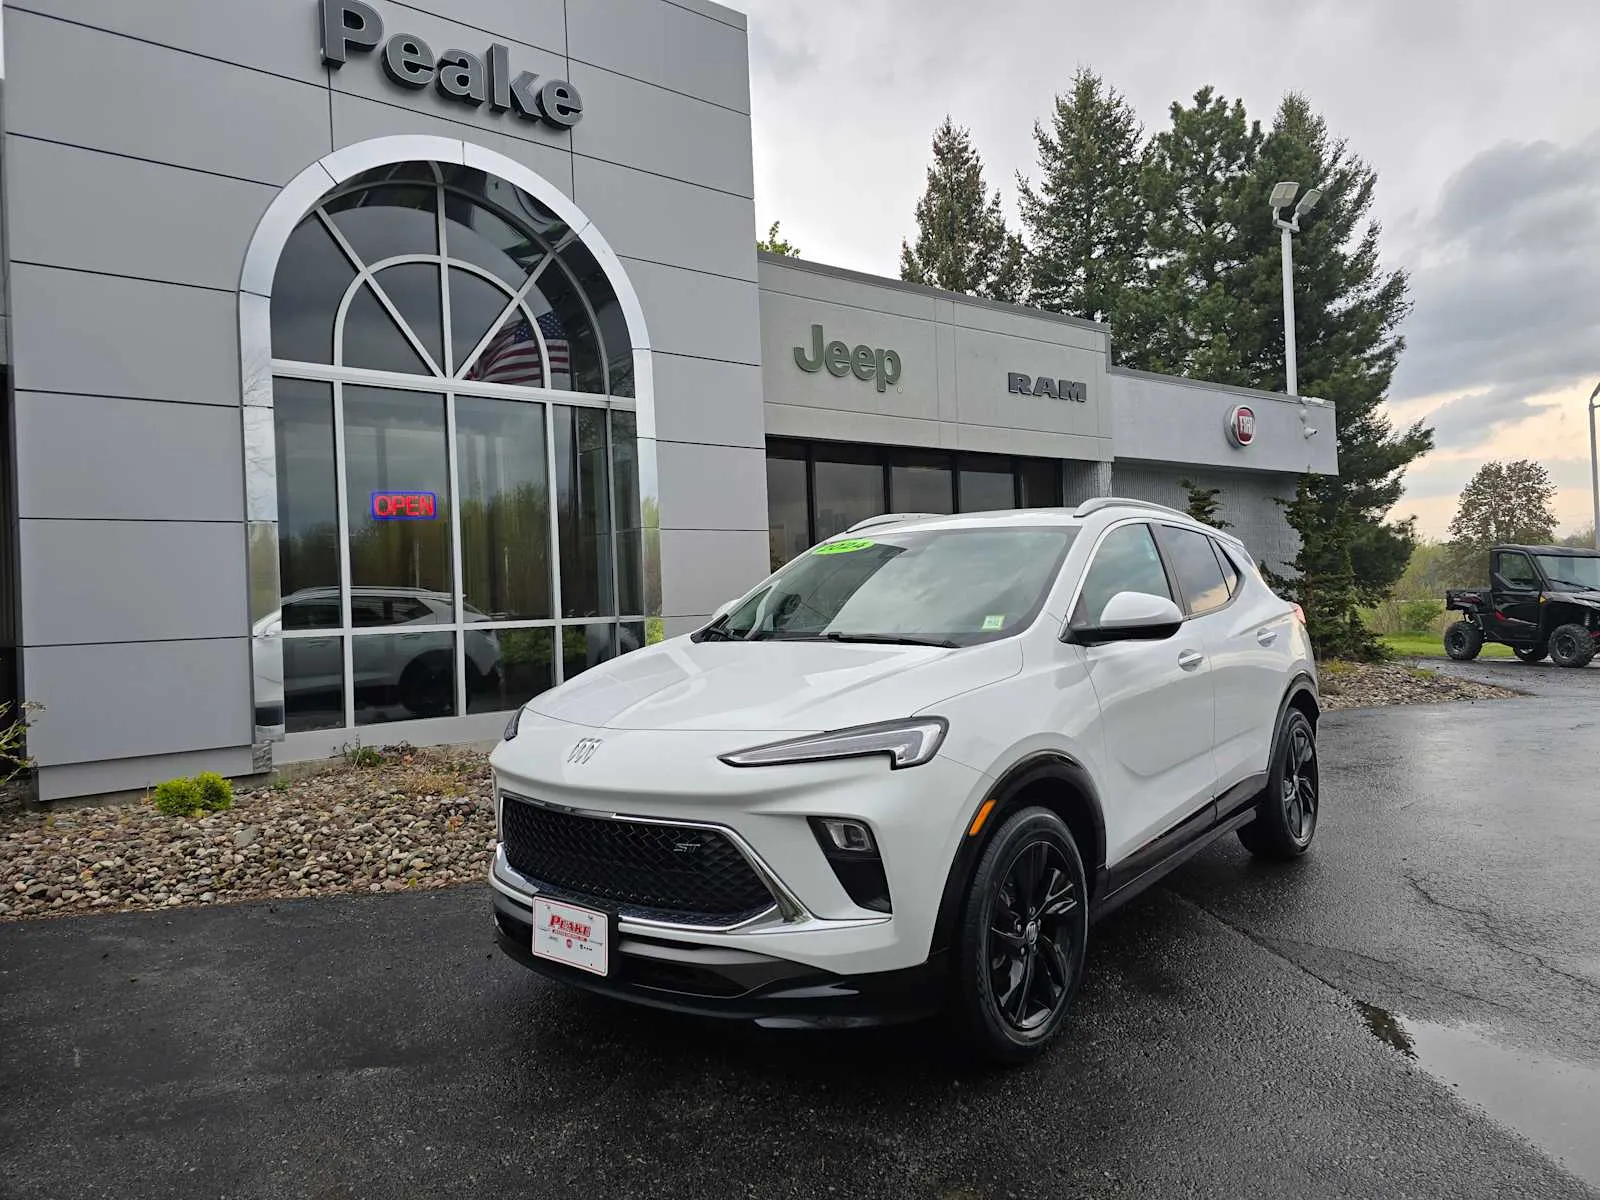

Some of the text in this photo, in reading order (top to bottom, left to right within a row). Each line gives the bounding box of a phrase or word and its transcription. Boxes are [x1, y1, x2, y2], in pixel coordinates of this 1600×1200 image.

[320, 0, 583, 129] Peake
[793, 324, 902, 393] Jeep
[1007, 372, 1087, 402] RAM
[374, 495, 434, 516] OPEN
